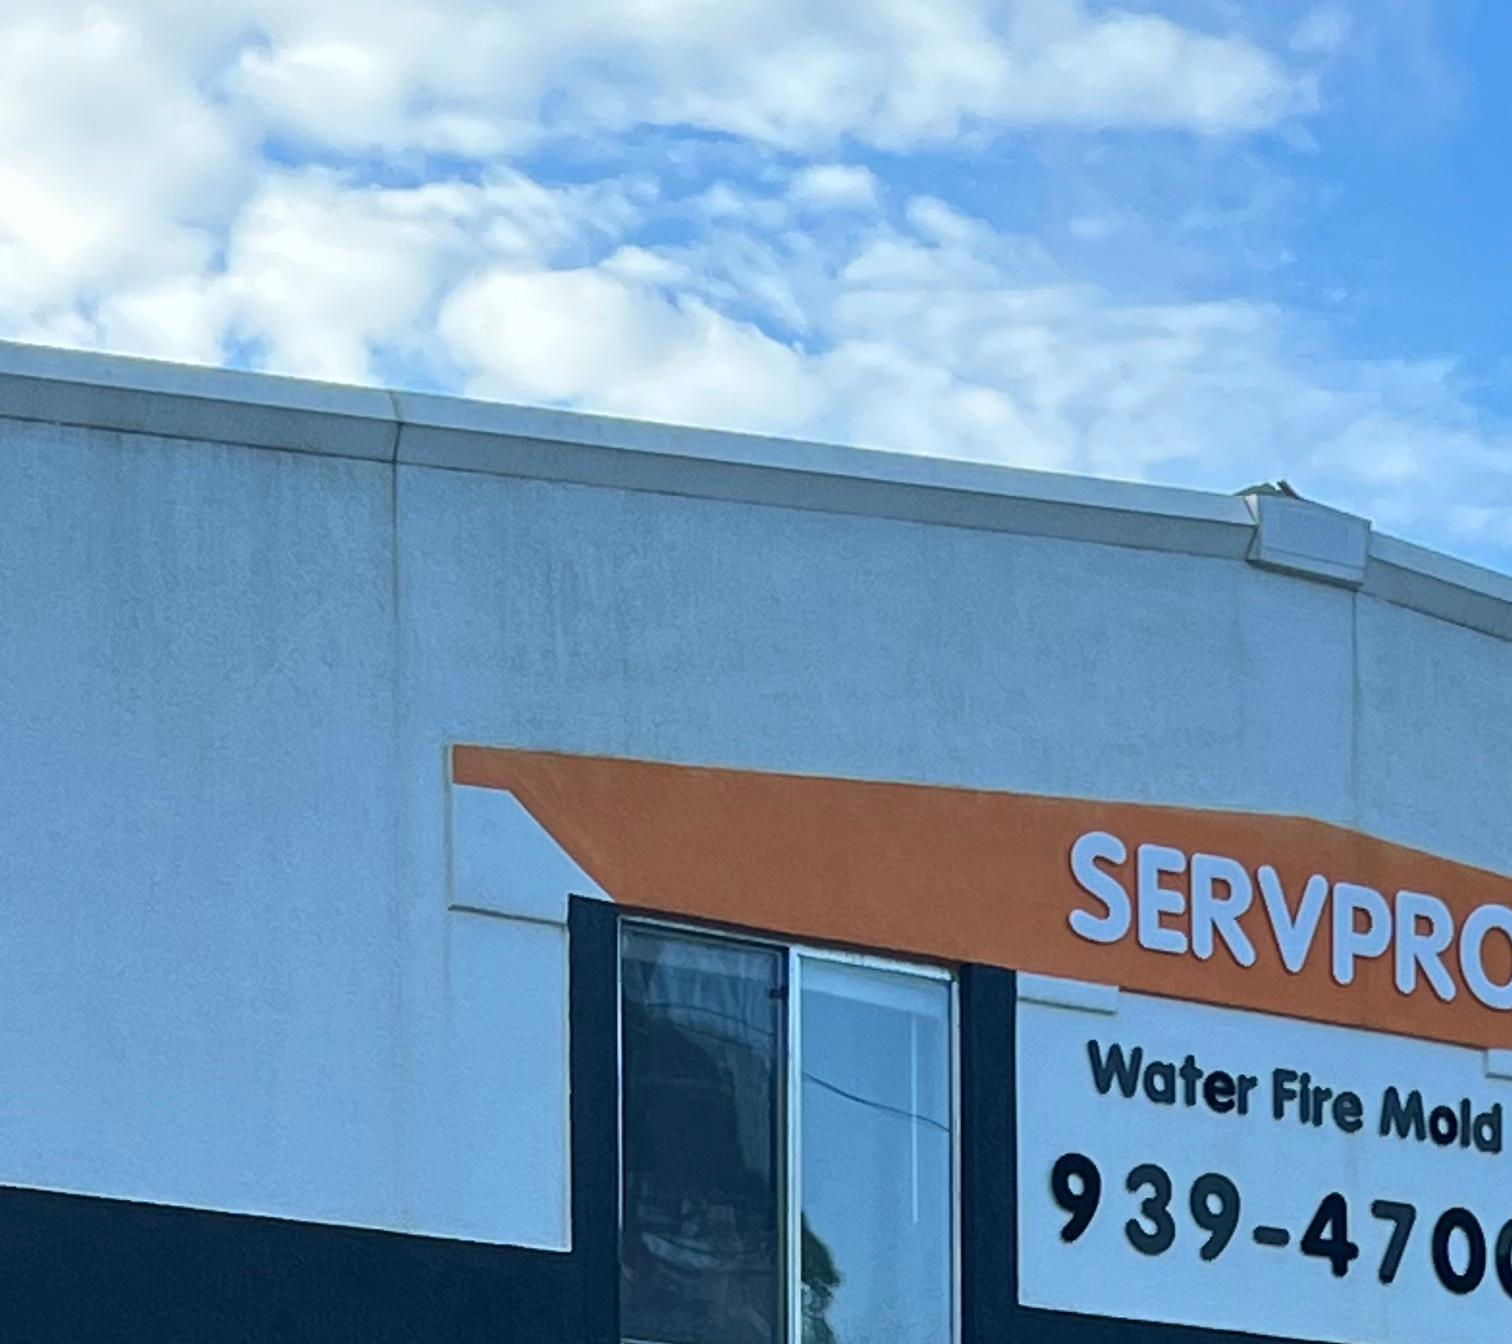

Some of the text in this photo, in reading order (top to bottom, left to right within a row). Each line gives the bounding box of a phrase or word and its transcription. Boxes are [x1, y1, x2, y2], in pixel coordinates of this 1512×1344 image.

[1087, 1040, 1502, 1154] Water Fire Mold
